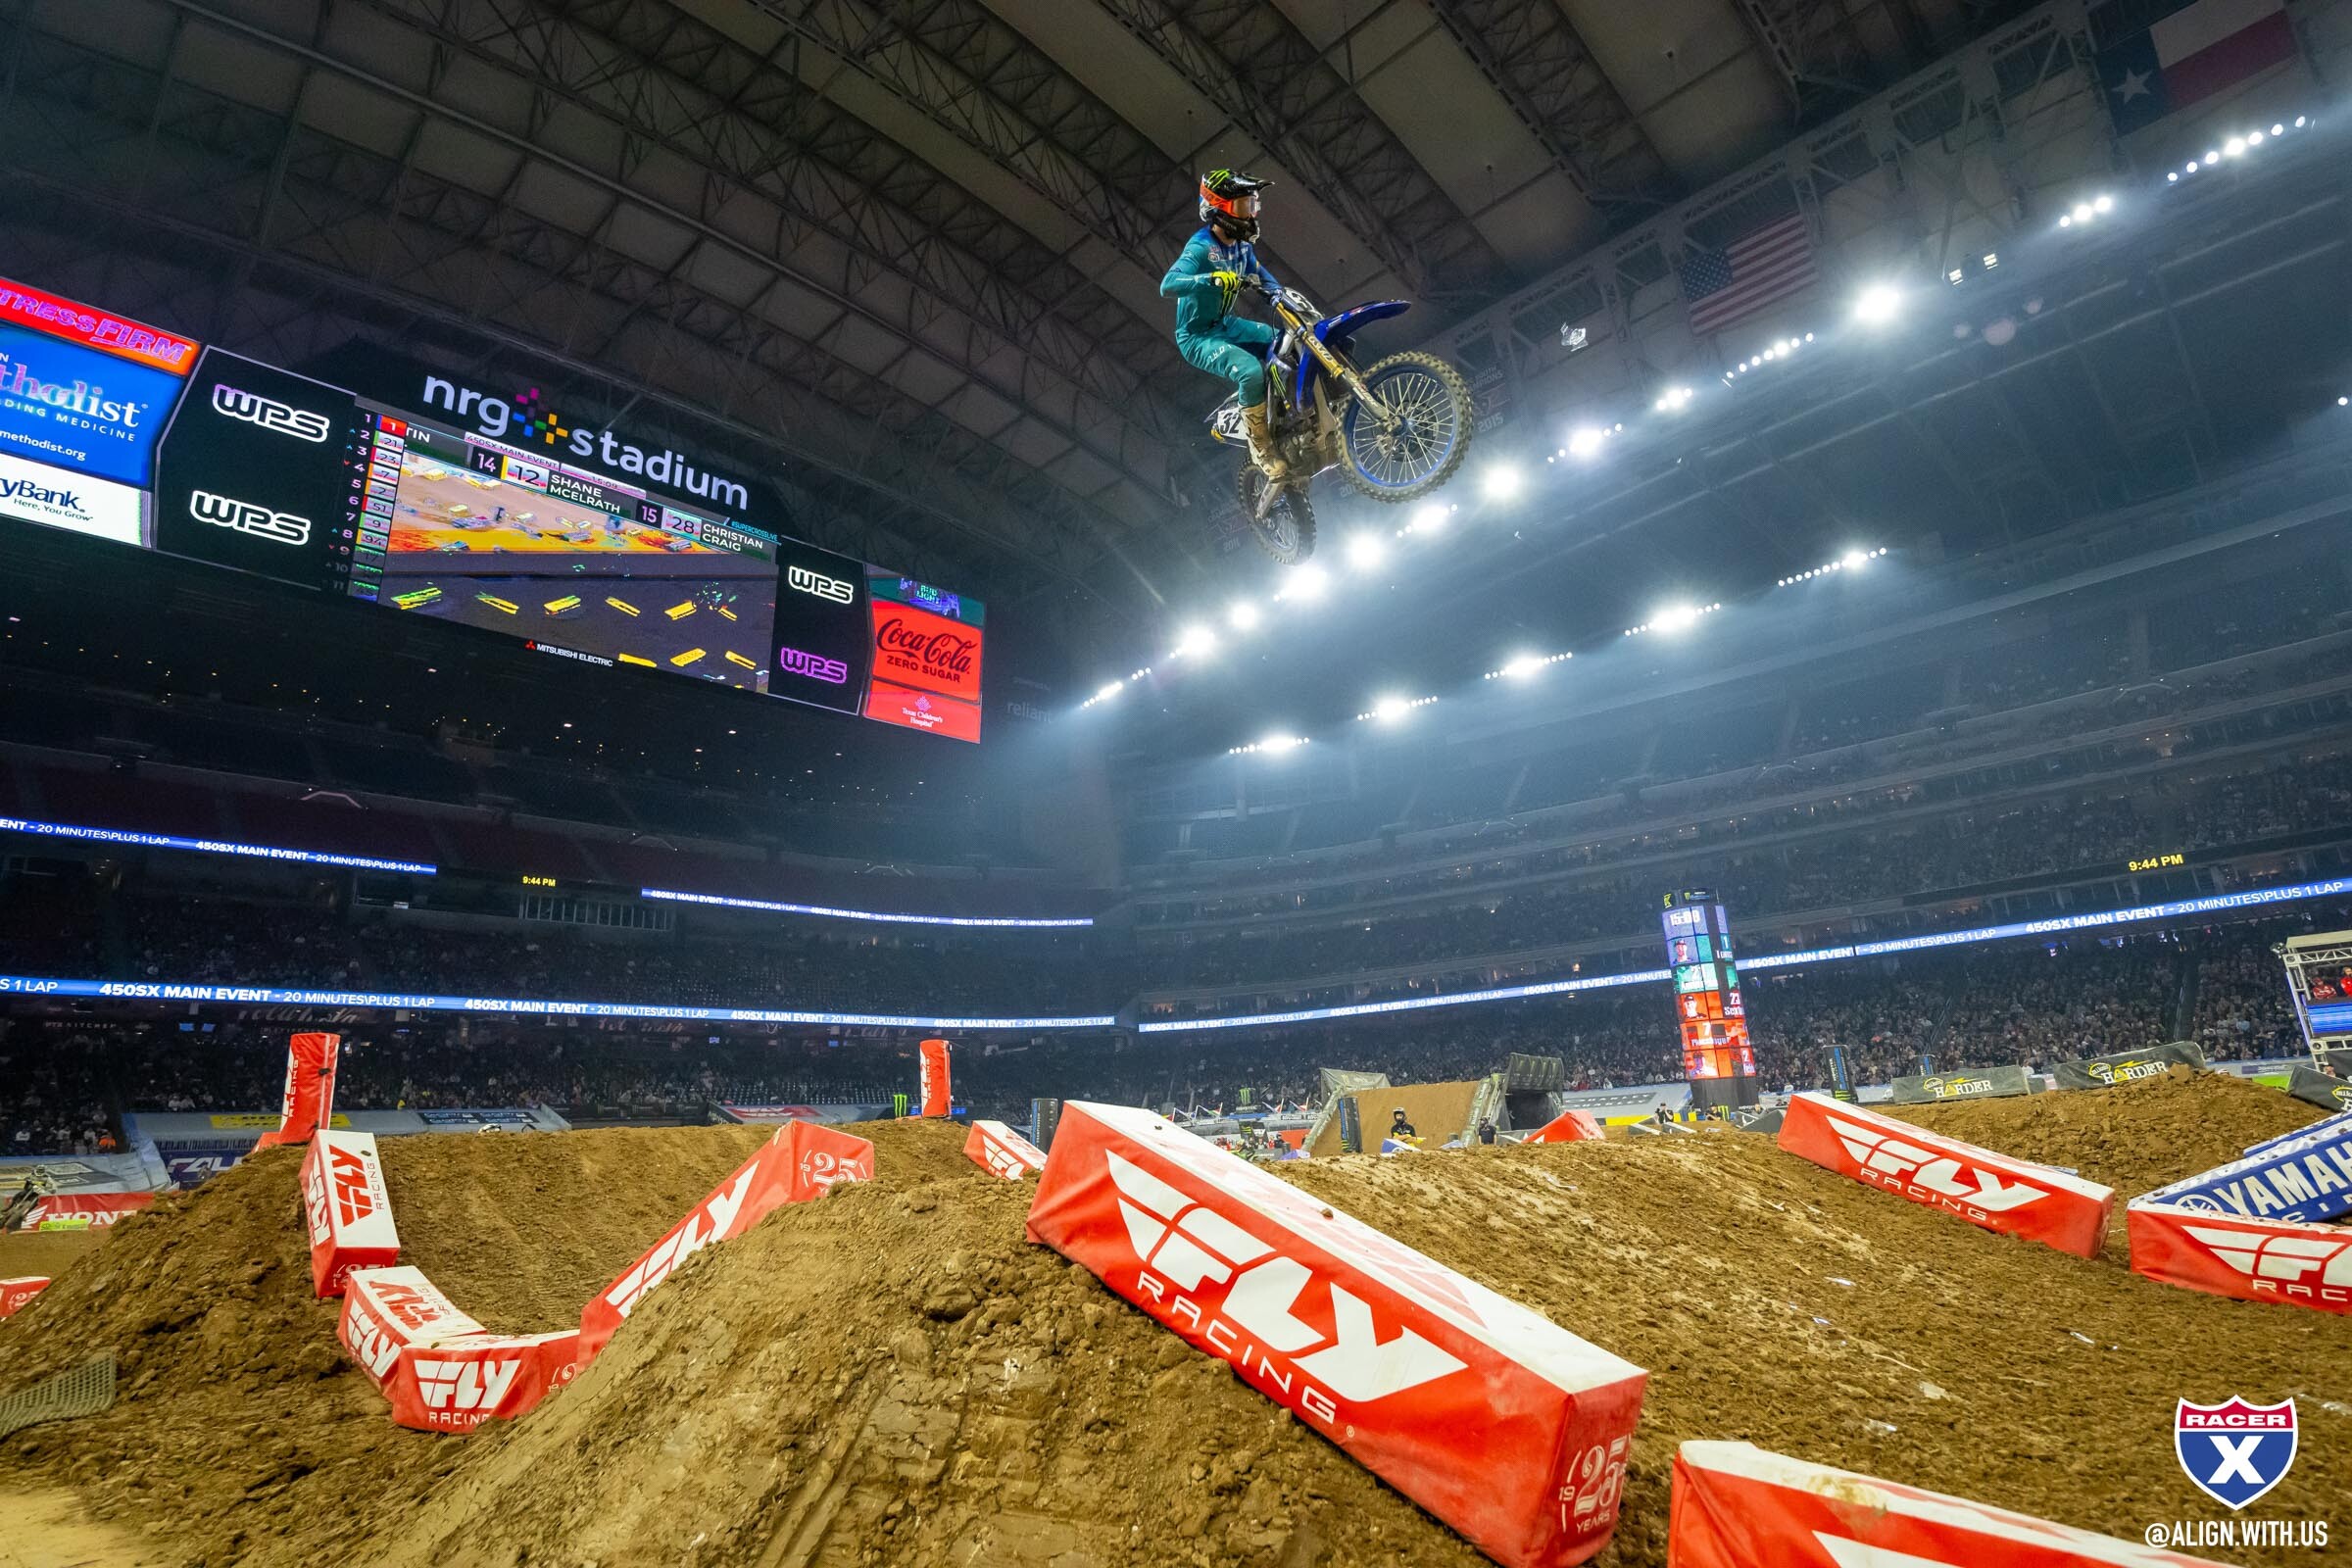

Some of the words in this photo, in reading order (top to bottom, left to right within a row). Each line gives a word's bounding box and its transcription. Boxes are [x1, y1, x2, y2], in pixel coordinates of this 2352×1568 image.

[213, 383, 329, 442] WPS
[365, 414, 371, 422] 1
[1220, 413, 1242, 434] 32
[56, 413, 135, 442] MEDICINE
[361, 429, 369, 440] 2
[383, 437, 398, 448] 21
[357, 446, 368, 456] 3
[380, 453, 396, 465] 23
[423, 375, 511, 437] nrg
[568, 427, 748, 510] stadium
[467, 435, 497, 450] 450SX
[500, 444, 525, 459] MAIN
[527, 453, 557, 468] EVENT
[354, 464, 365, 472] 4
[477, 453, 496, 472] 14
[514, 464, 540, 487] 12
[352, 478, 362, 488] 5
[551, 474, 602, 498] SHANE
[14, 498, 40, 511] Here,
[44, 506, 62, 515] You
[349, 496, 359, 506] 6
[550, 485, 620, 514] MCELRATH
[190, 490, 312, 546] WPS
[346, 512, 356, 521] 7
[642, 506, 658, 523] 15
[672, 515, 695, 534] 28
[342, 529, 353, 538] 8
[702, 533, 741, 552] CRAIG
[703, 523, 763, 550] CHRISTIAN
[789, 566, 854, 604] WPS
[537, 643, 578, 660] MITSUBISHI
[578, 654, 613, 666] ELECTRIC
[781, 647, 847, 684] WPS
[887, 655, 918, 671] ZERO
[922, 664, 960, 683] SUGAR
[37, 824, 53, 833] 20
[149, 836, 170, 845] LAP
[196, 841, 235, 854] 450SX
[237, 846, 269, 857] MAIN
[271, 849, 308, 860] EVENT
[316, 854, 328, 862] 20
[404, 863, 421, 872] LAP
[2129, 858, 2159, 871] 9:44
[2161, 854, 2183, 866] PM
[522, 875, 541, 886] 9:44
[543, 877, 556, 887] PM
[2026, 917, 2071, 934] 450SX
[2074, 911, 2113, 929] MAIN
[2115, 906, 2164, 923] EVENT
[2178, 902, 2195, 913] 20
[2315, 881, 2343, 895] LAP
[1747, 955, 1783, 967] 450SX
[1786, 951, 1816, 963] MAIN
[1819, 945, 1860, 959] EVENT
[1870, 944, 1884, 954] 20
[1976, 928, 1995, 940] LAP
[25, 981, 58, 992] LAP
[99, 983, 159, 998] 450SX
[164, 986, 213, 1000] MAIN
[216, 988, 271, 1002] EVENT
[283, 992, 301, 1002] 20
[412, 998, 435, 1007] LAP
[465, 999, 508, 1010] 450SX
[511, 1001, 544, 1012] MAIN
[548, 1003, 588, 1013] EVENT
[597, 1005, 611, 1014] 20
[692, 1009, 709, 1018] LAP
[731, 1010, 763, 1020] 450SX
[766, 1011, 792, 1021] MAIN
[794, 1013, 823, 1023] EVENT
[2101, 1061, 2170, 1085] HARDER
[1935, 1080, 1993, 1099] HARDER
[1826, 1115, 2050, 1211] FLY
[328, 1145, 373, 1228] FLY
[367, 1161, 385, 1210] RACING
[1860, 1167, 1988, 1222] RACING
[1105, 1149, 1468, 1402] FLY
[348, 1298, 402, 1378] FLY
[1137, 1271, 1337, 1424] RACING
[415, 1359, 520, 1408] FLY
[1573, 1435, 1628, 1518] 25
[1576, 1509, 1610, 1534] YEARS
